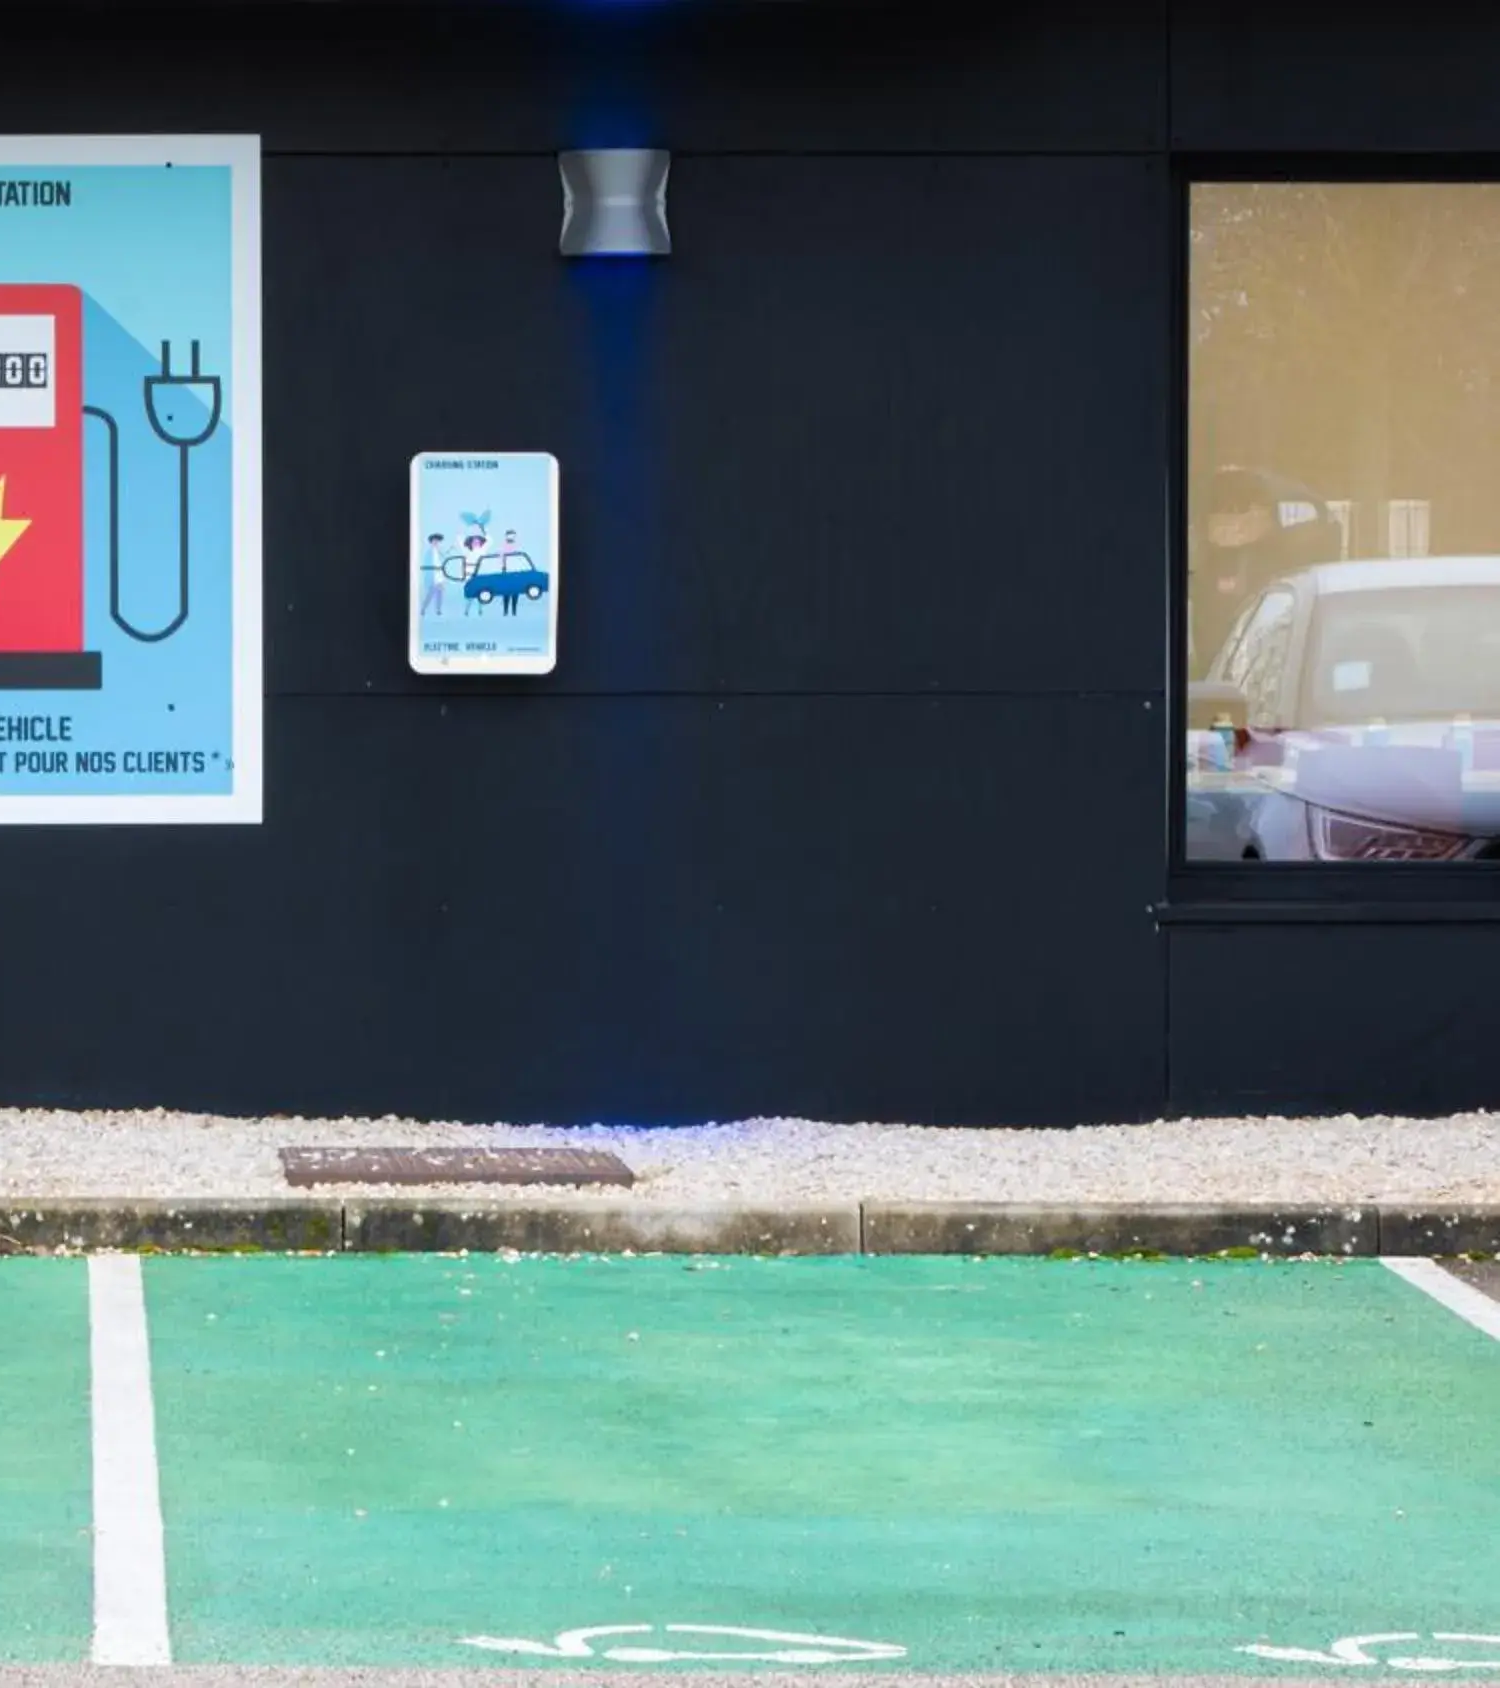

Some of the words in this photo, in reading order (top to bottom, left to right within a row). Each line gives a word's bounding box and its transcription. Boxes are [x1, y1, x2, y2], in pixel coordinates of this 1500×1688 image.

[14, 751, 69, 774] POUR
[75, 751, 117, 774] NOS
[122, 751, 206, 774] CLIENTS
